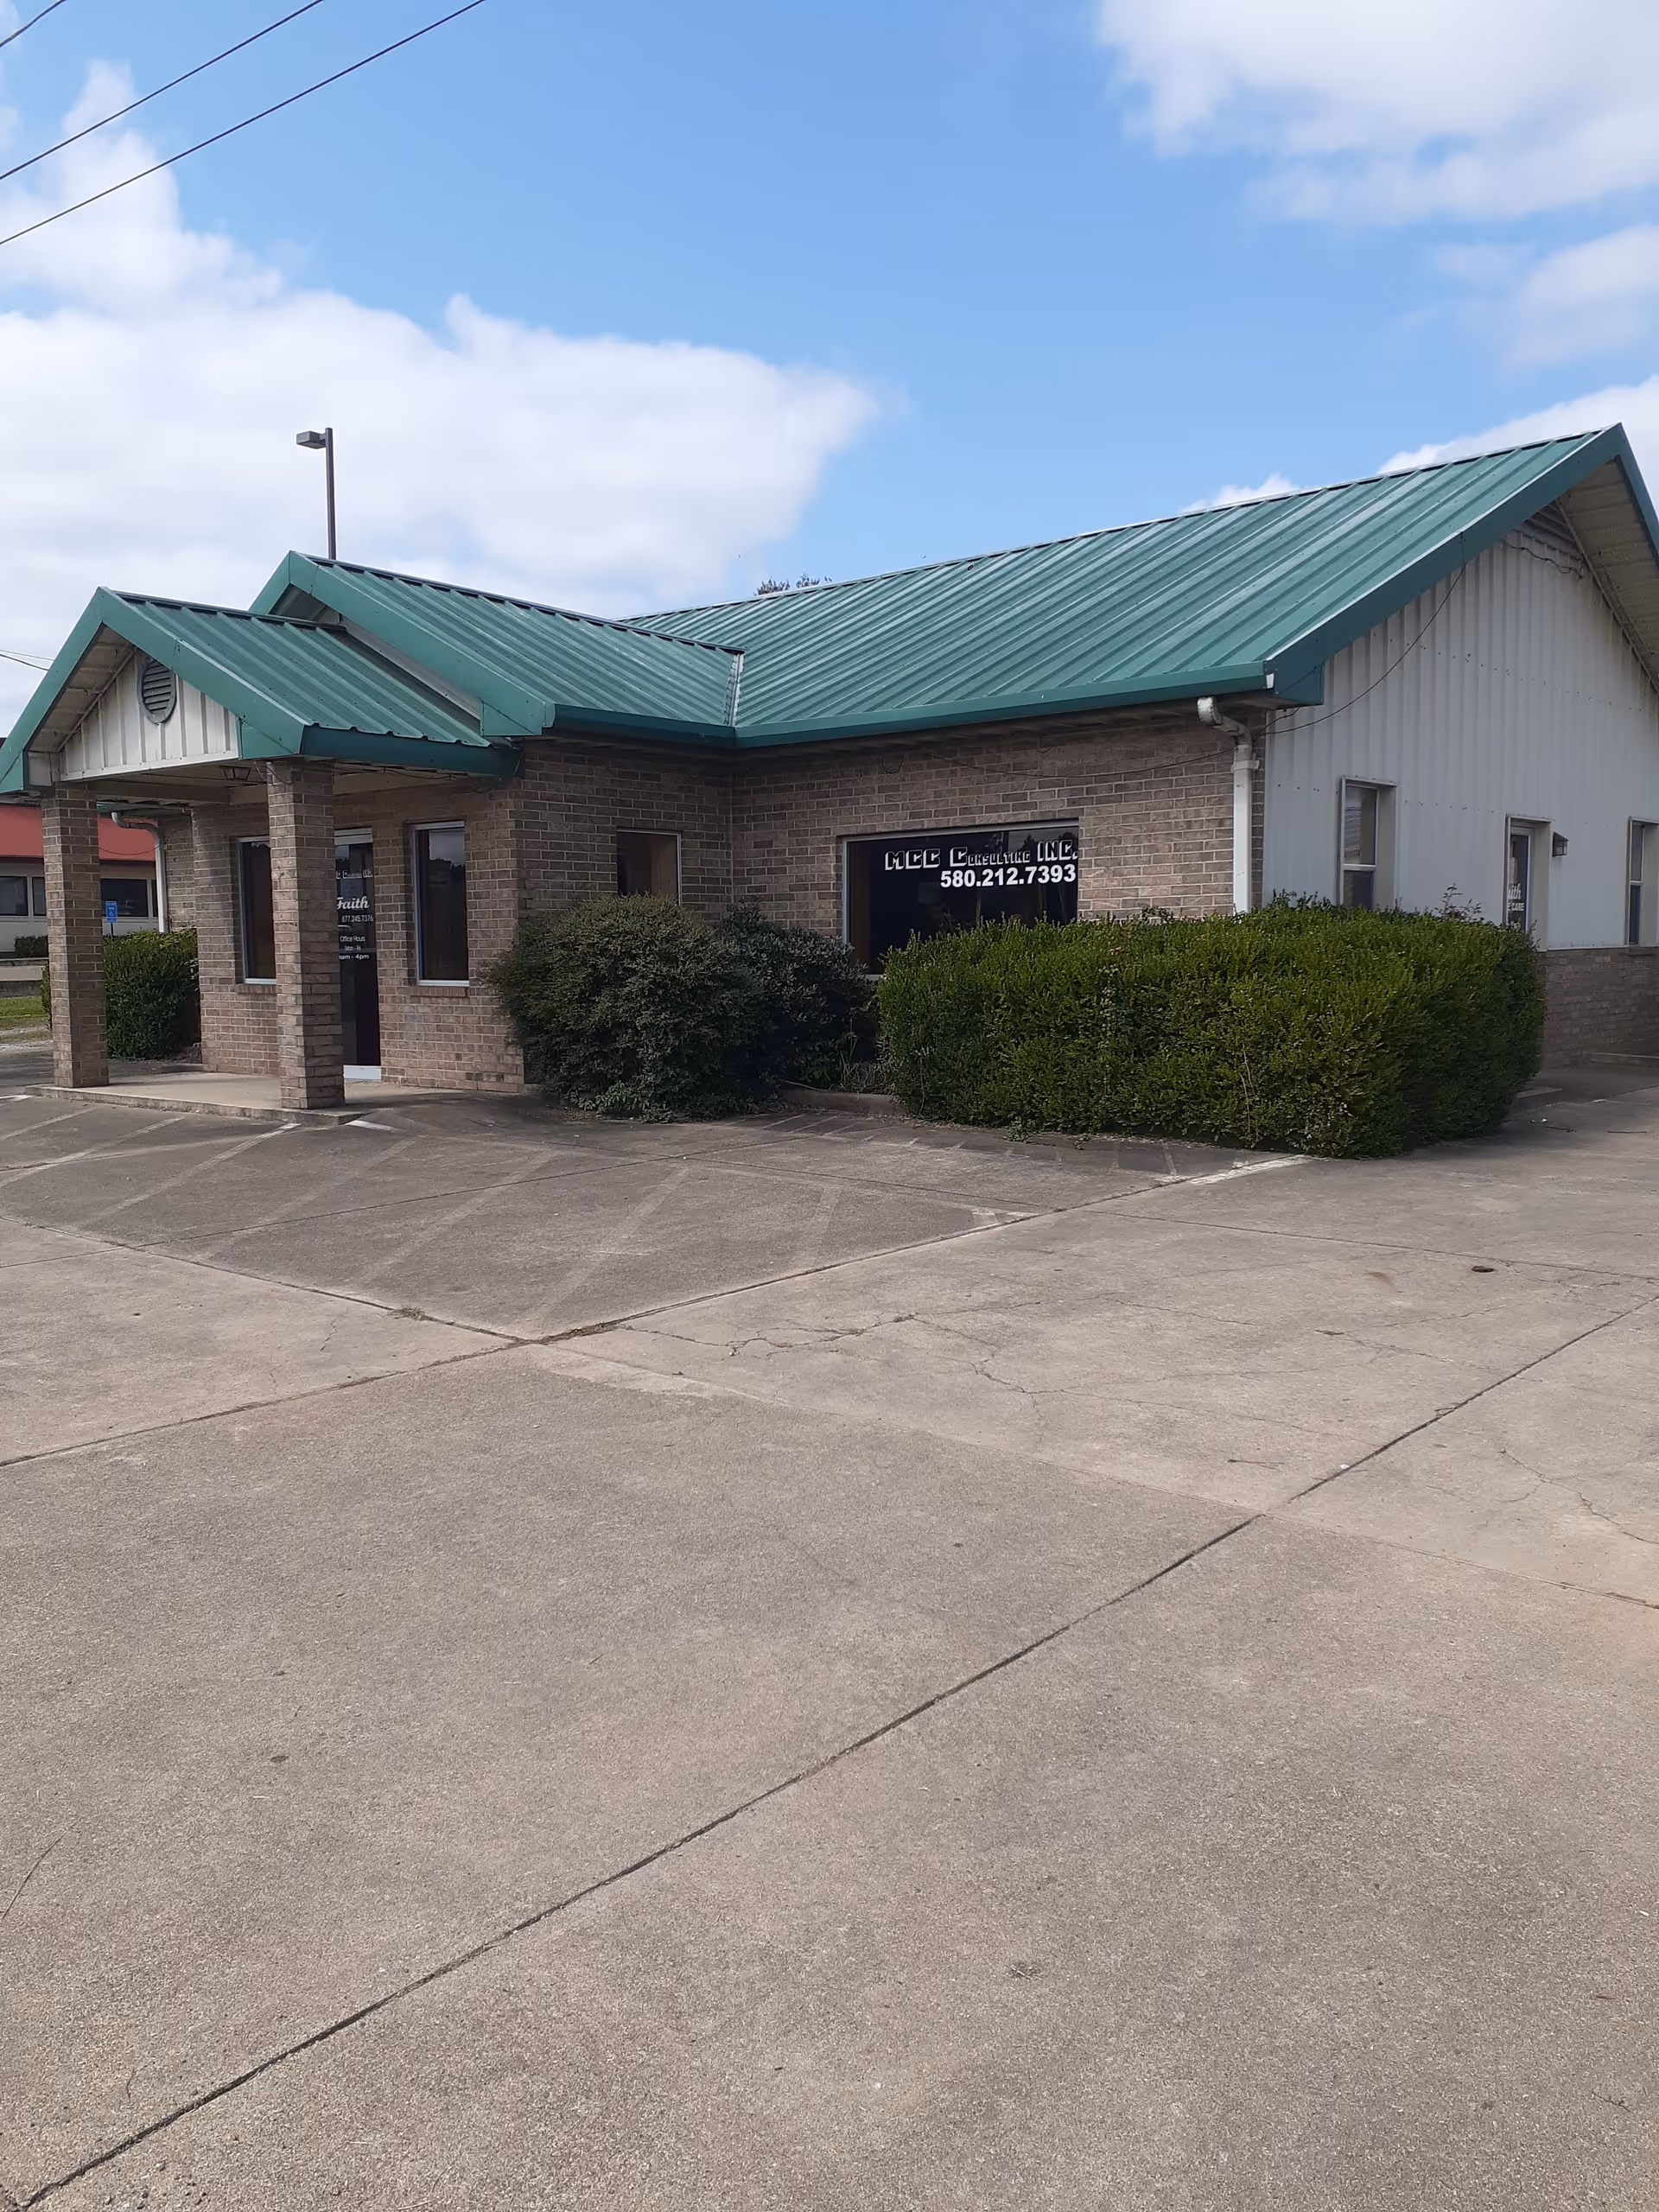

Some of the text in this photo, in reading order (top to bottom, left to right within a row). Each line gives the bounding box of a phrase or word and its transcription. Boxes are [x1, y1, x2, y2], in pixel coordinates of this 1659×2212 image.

[885, 848, 940, 870] MCC
[1037, 840, 1078, 861] INC.
[940, 864, 1076, 888] 580.212.7393
[337, 896, 369, 910] Faith
